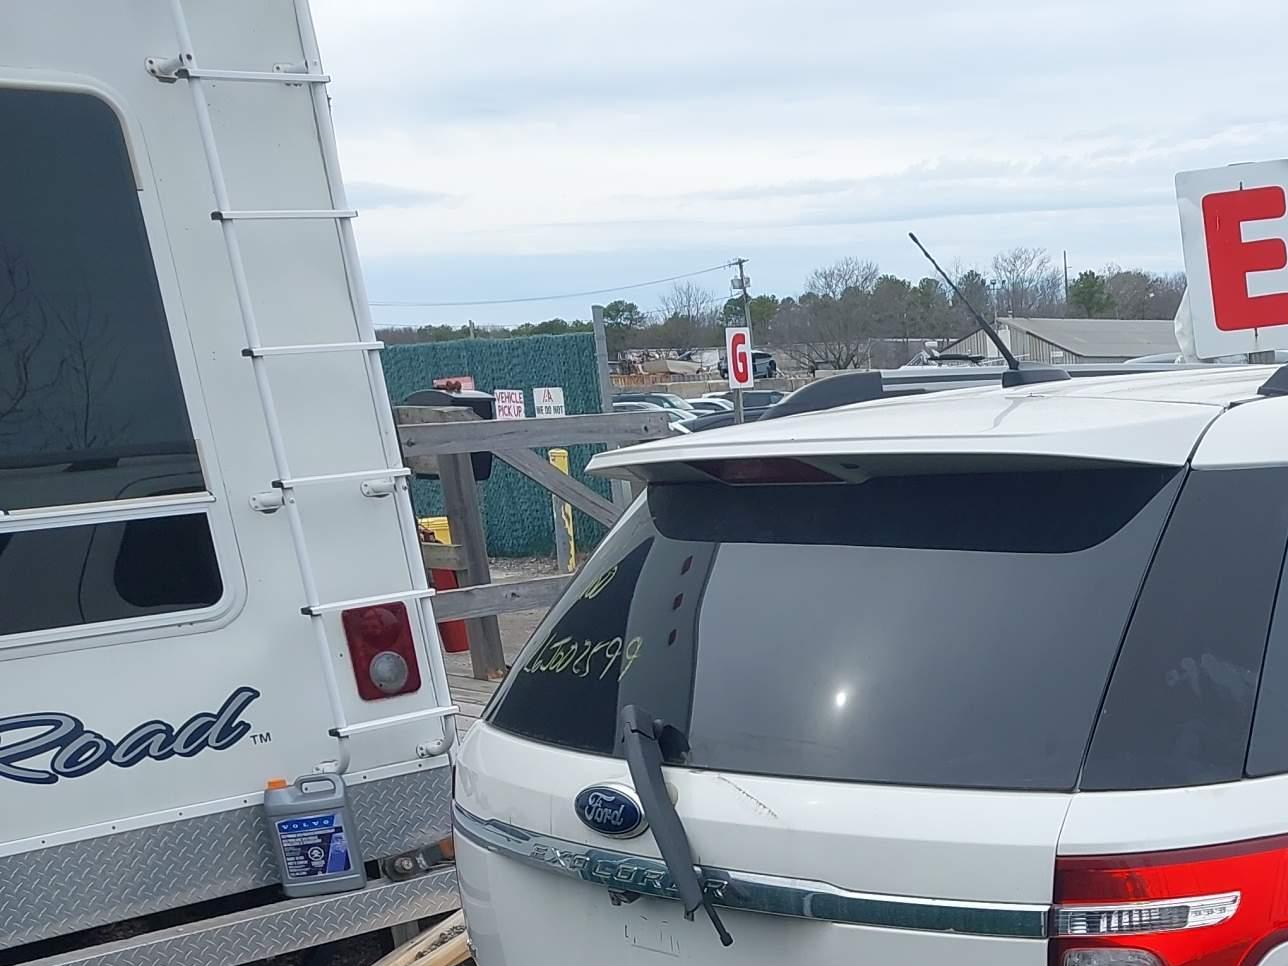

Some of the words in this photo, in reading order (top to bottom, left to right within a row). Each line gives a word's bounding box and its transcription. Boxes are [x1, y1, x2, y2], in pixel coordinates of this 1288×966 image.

[731, 332, 749, 384] G
[495, 391, 523, 404] VEHICLE
[498, 405, 513, 417] PICK
[513, 404, 522, 417] UP
[545, 405, 552, 415] DO
[552, 405, 564, 415] NOT
[0, 686, 261, 785] Road
[251, 732, 272, 745] TM
[585, 791, 625, 826] Ford
[281, 819, 330, 830] VOLVO
